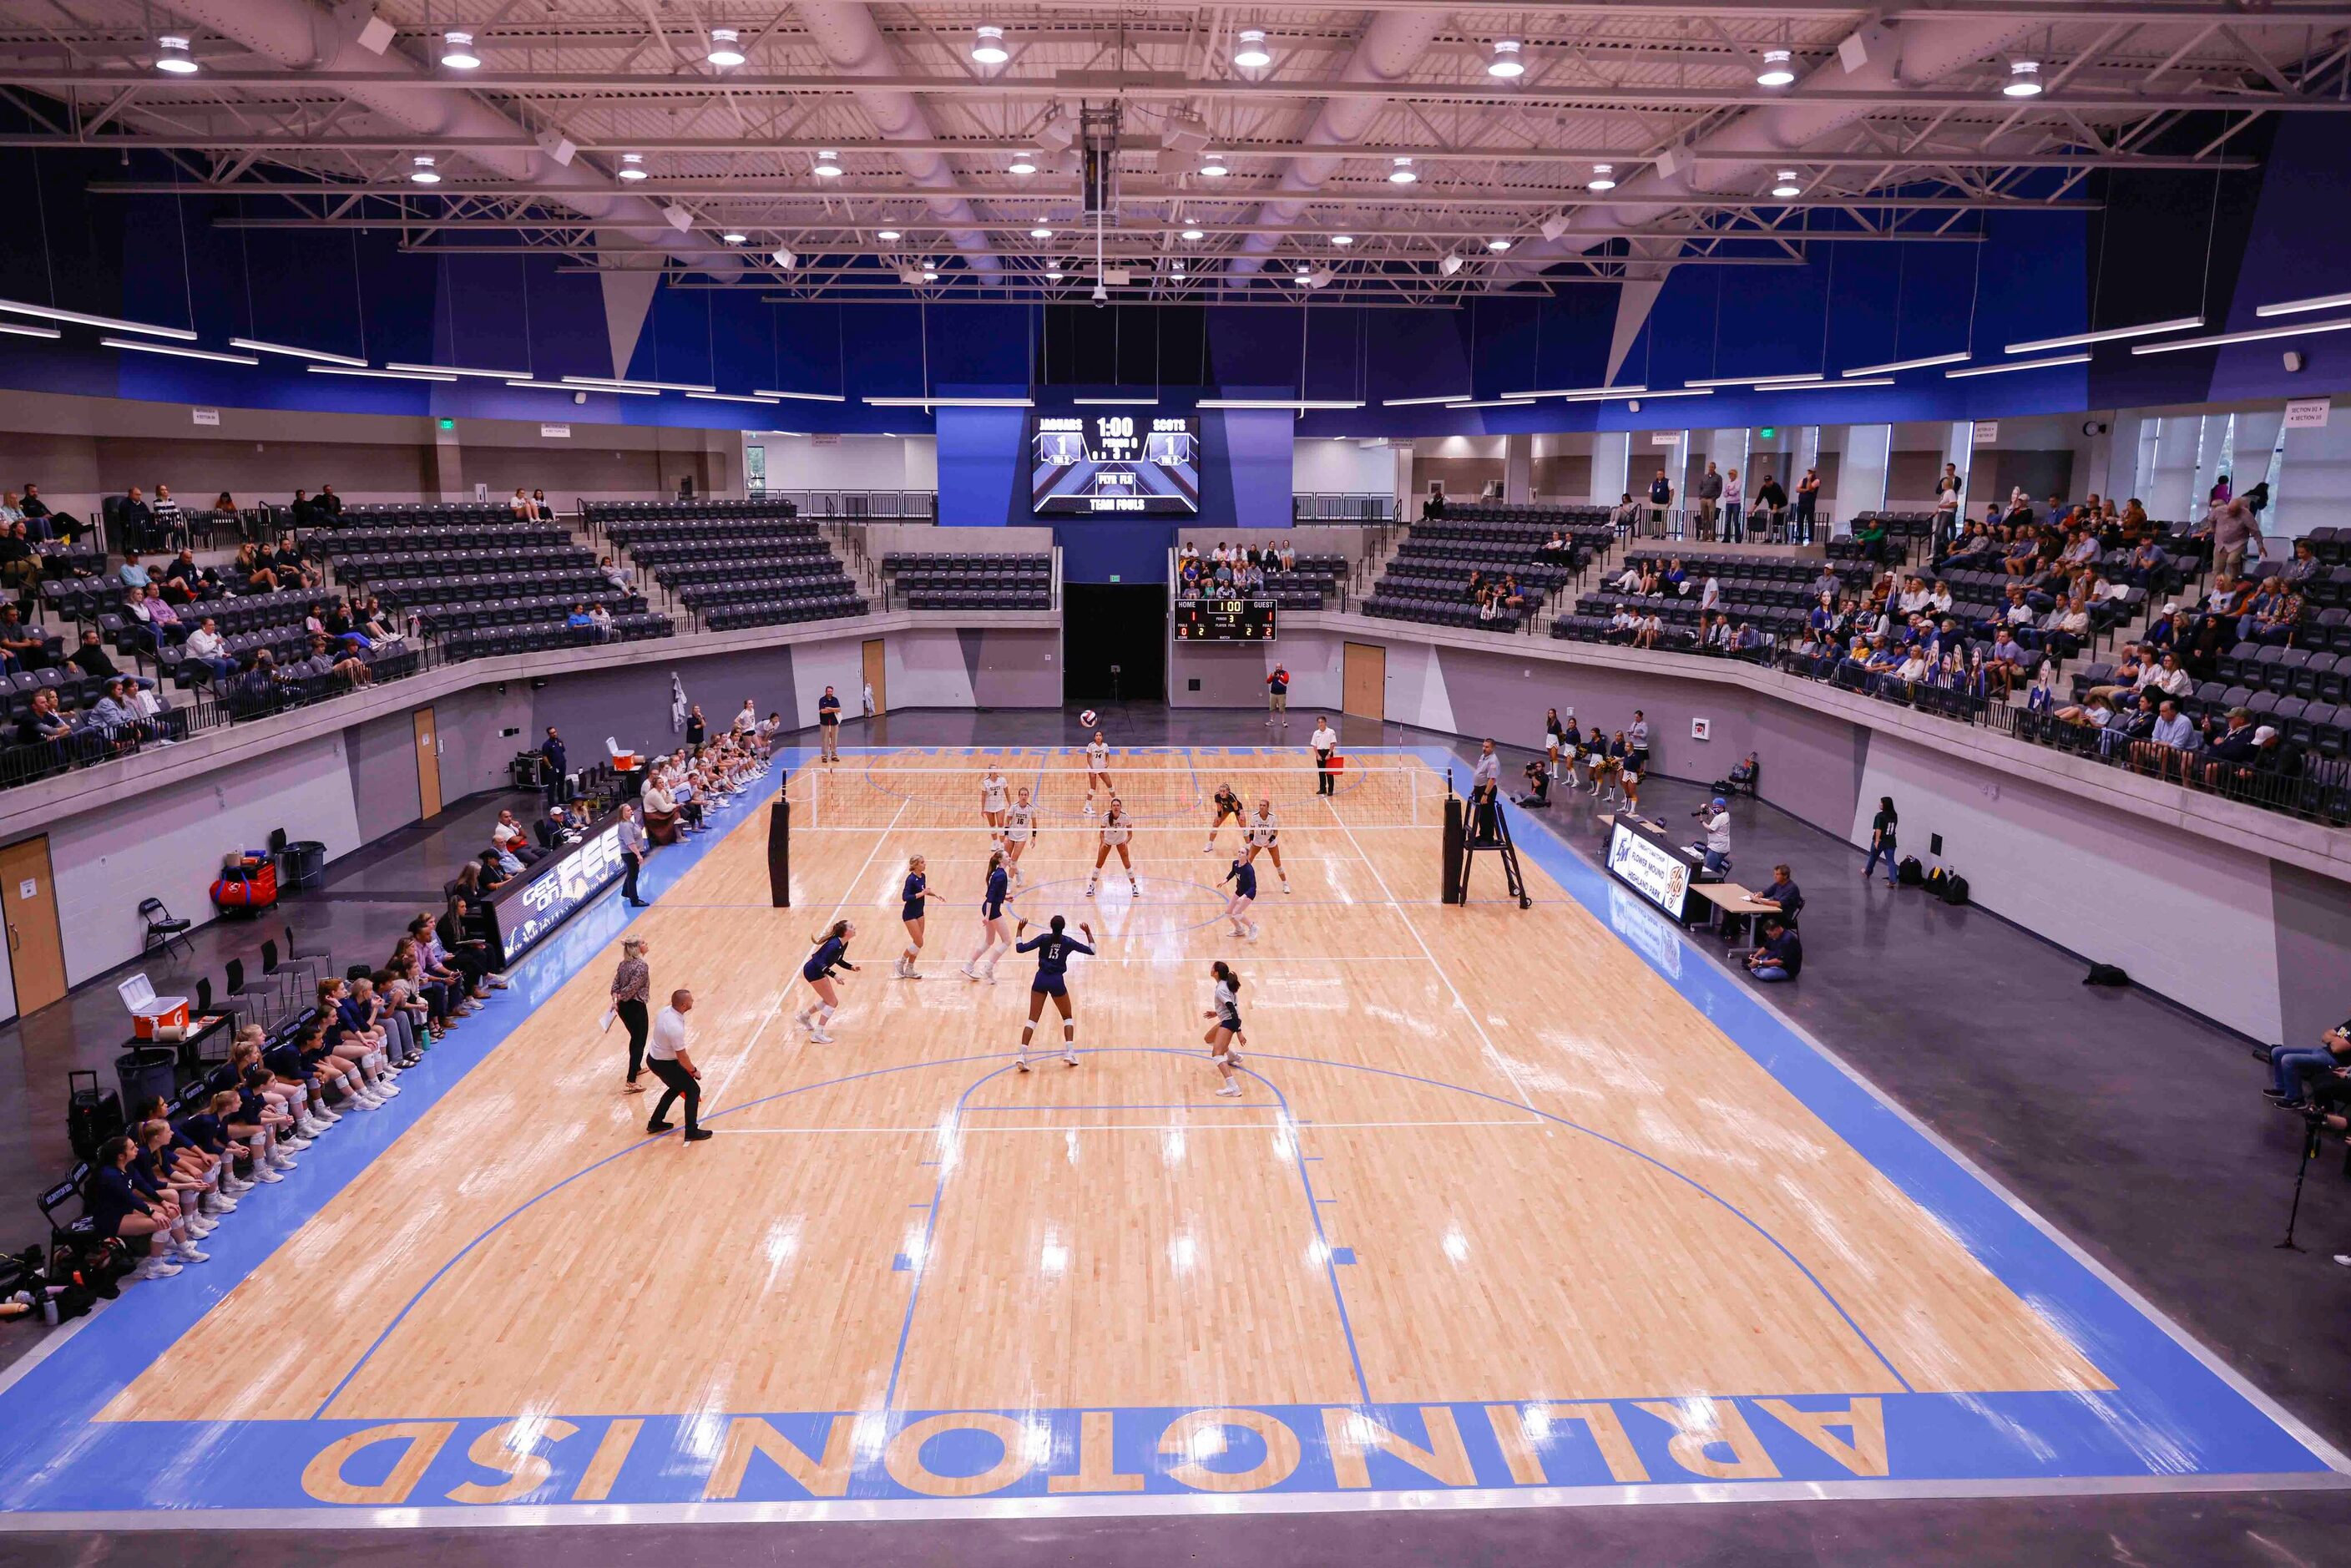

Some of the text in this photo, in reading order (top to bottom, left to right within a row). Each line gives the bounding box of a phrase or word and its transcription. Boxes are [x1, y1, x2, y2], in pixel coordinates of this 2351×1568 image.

[1039, 418, 1083, 431] JAGUARS
[1097, 417, 1134, 438] 1:00
[1153, 419, 1186, 431] SCOTS
[1056, 435, 1066, 455] 1
[1164, 436, 1174, 455] 1
[1090, 499, 1145, 510] TEAM FOULS
[1192, 612, 1196, 620] 1
[1230, 615, 1234, 623] 3
[1269, 612, 1272, 620] 1
[1631, 852, 1665, 879] FLOWER MOUND
[1628, 870, 1661, 899] HIGHLAND PARK
[537, 888, 560, 912] ON
[1048, 948, 1059, 959] 13
[174, 1009, 183, 1026] G
[301, 1398, 1888, 1504] ARLINGTON ISD
